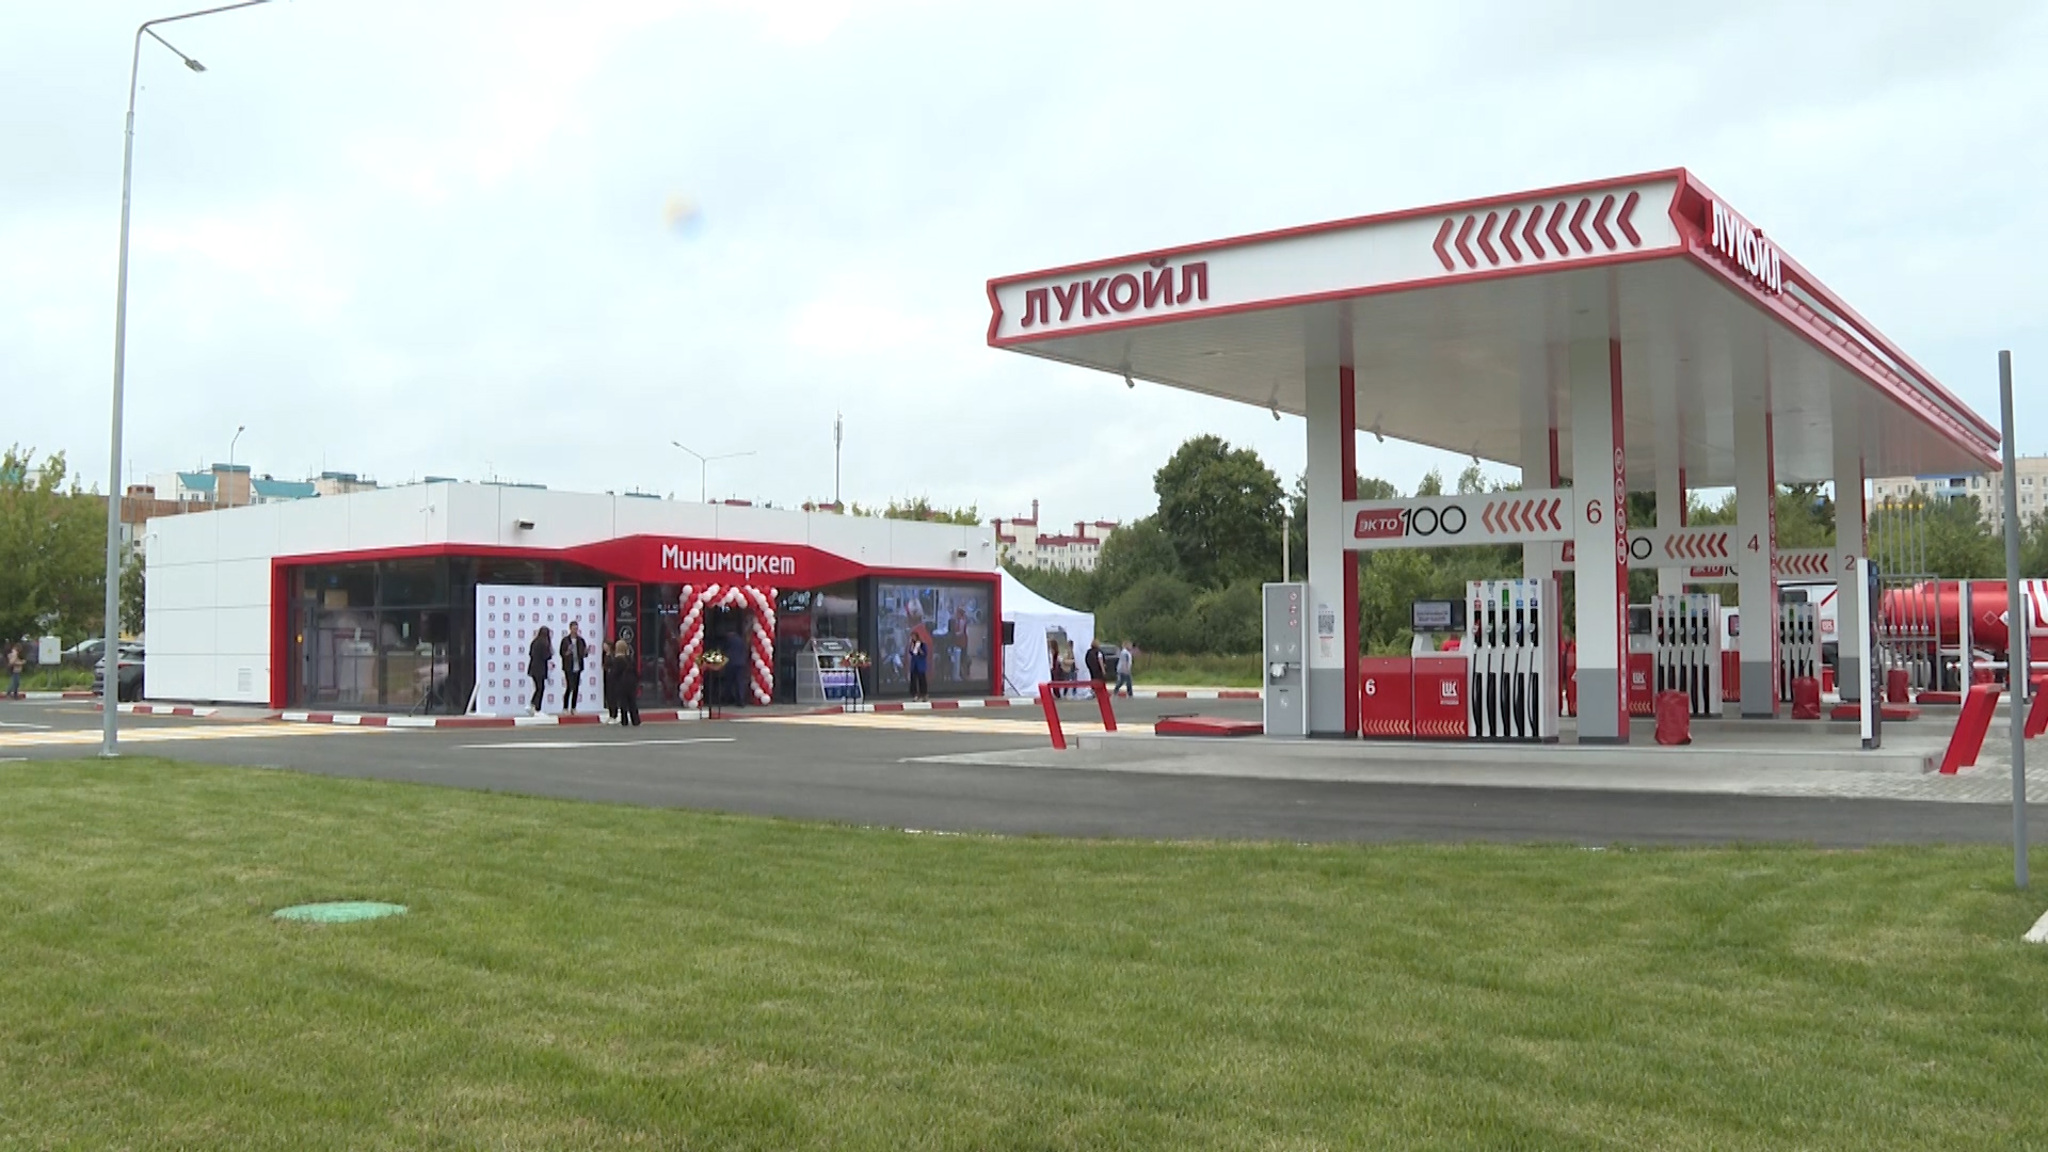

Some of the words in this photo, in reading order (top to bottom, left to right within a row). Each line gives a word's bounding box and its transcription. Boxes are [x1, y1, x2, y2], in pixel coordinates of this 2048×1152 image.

[1711, 198, 1782, 295] ЛУКОЙЛ
[1021, 258, 1208, 327] ЛУКОЙЛ
[1401, 505, 1467, 536] 100
[1586, 499, 1602, 524] 6
[1747, 533, 1760, 553] 4
[661, 544, 796, 581] Минимаркет
[1844, 554, 1855, 571] 2
[1365, 678, 1376, 696] 6
